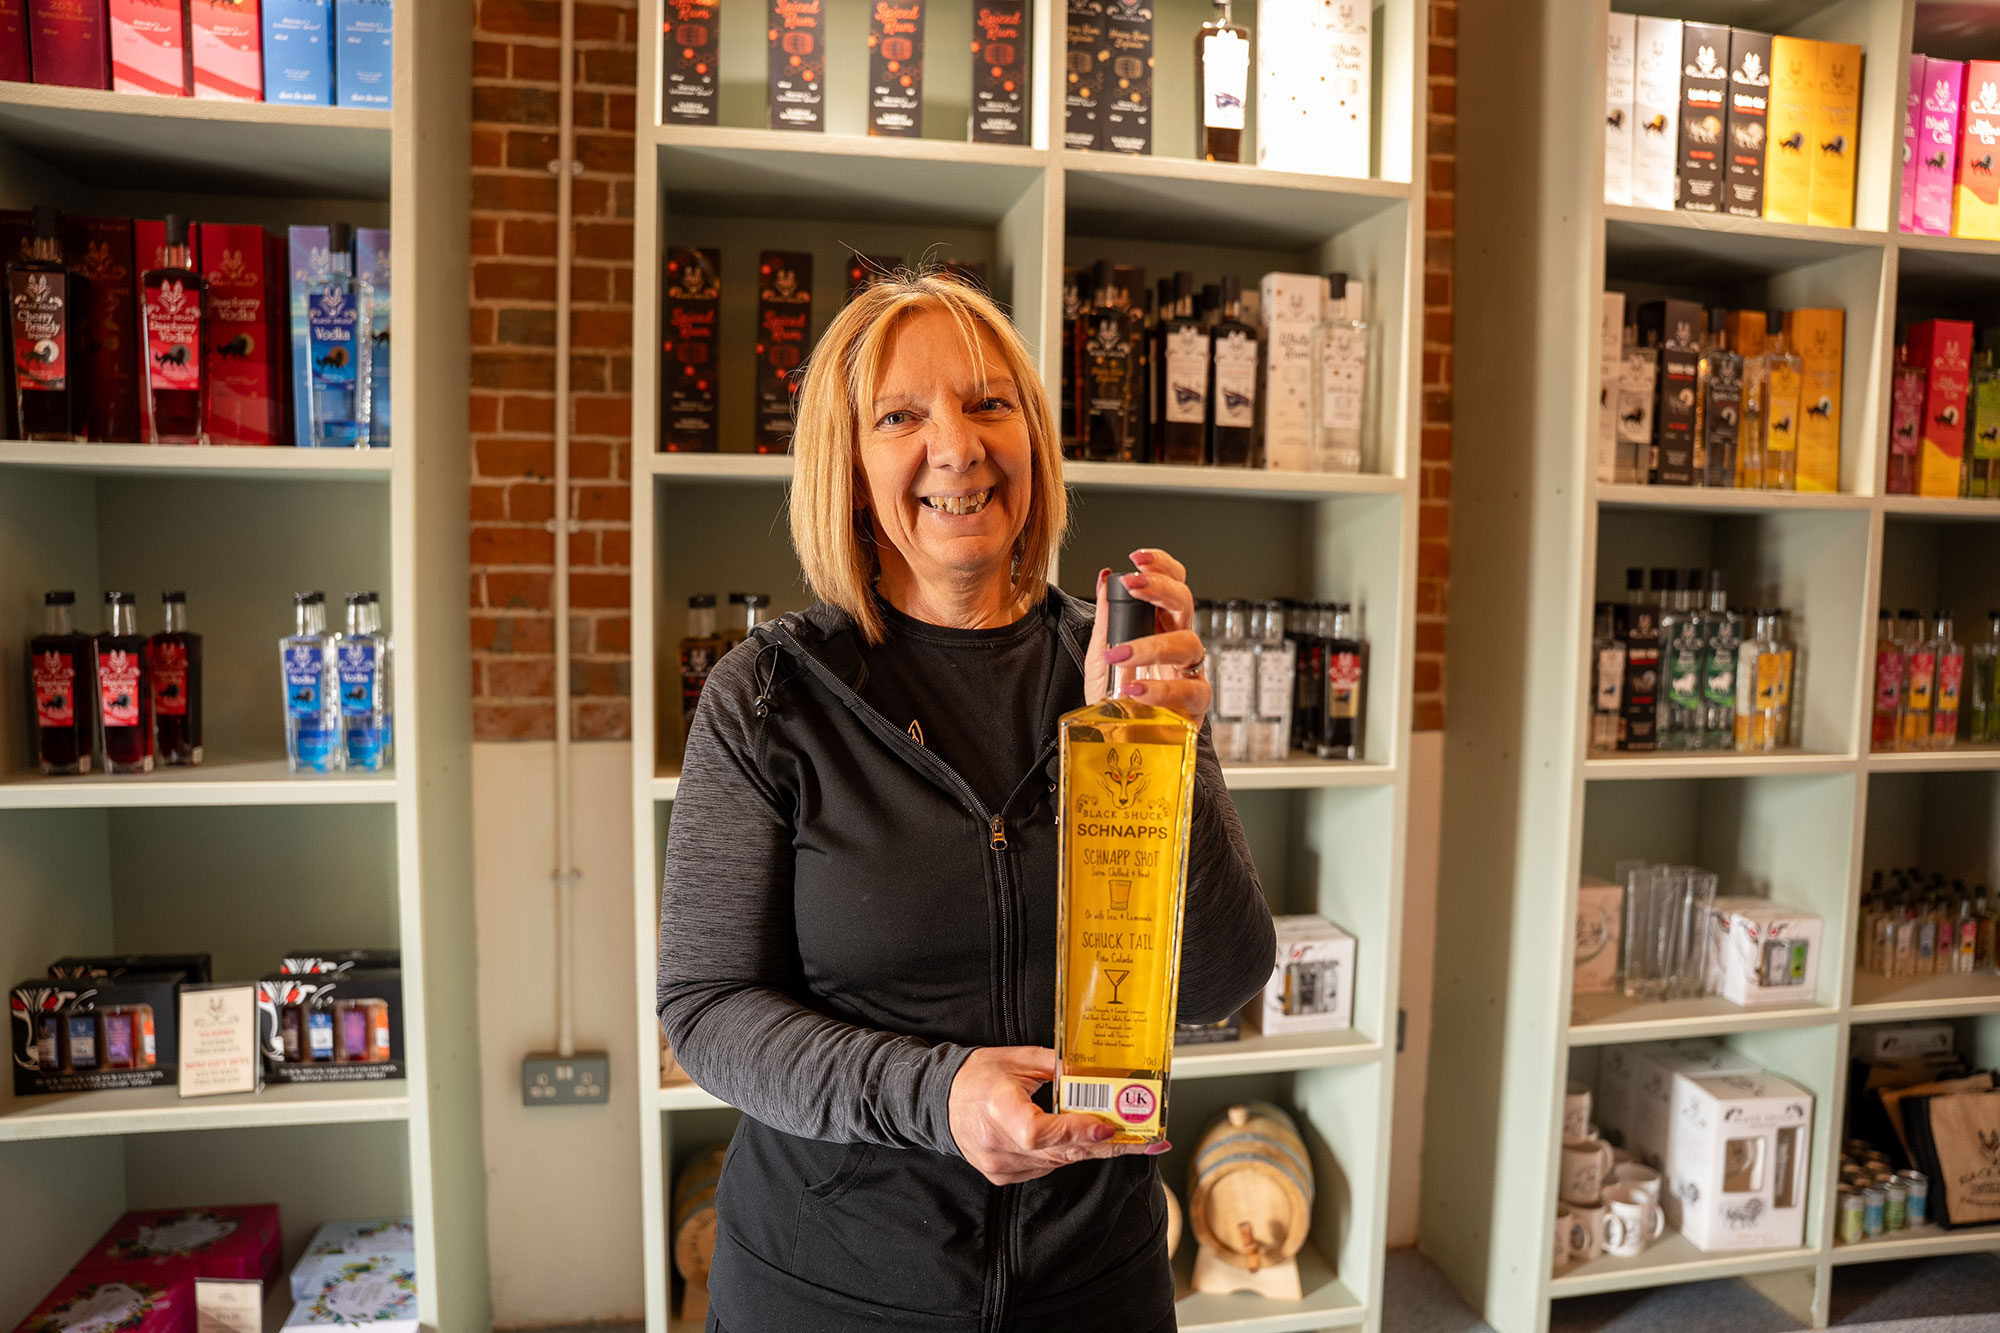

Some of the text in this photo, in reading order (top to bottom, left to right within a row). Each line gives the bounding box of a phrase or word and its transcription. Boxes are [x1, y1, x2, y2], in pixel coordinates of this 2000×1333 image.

[677, 3, 712, 21] Rum
[874, 1, 920, 21] Spiced
[977, 8, 1021, 27] Spiced
[783, 10, 818, 29] Rum
[882, 18, 917, 35] Rum
[986, 23, 1019, 40] Rum
[16, 310, 54, 325] Cherry
[218, 308, 256, 322] Vodka
[670, 307, 715, 328] Spiced
[762, 310, 807, 329] Spiced
[25, 320, 61, 336] Brandy
[149, 320, 197, 334] Raspberry
[314, 326, 351, 341] Vodka
[158, 331, 193, 344] Vodka
[290, 674, 317, 685] Vodka
[343, 673, 369, 683] Vodka
[1083, 809, 1162, 820] BLACK SHUCK
[1077, 823, 1168, 839] SCHNAPPS
[1083, 848, 1160, 867] SCHNAPP SHOT
[1108, 866, 1130, 877] Chilled
[1126, 911, 1153, 921] Lemonade
[1082, 931, 1154, 950] SCHUCK TAIL
[1111, 952, 1134, 963] Colada
[1142, 1056, 1157, 1066] 70cl
[1125, 1091, 1147, 1105] UK
